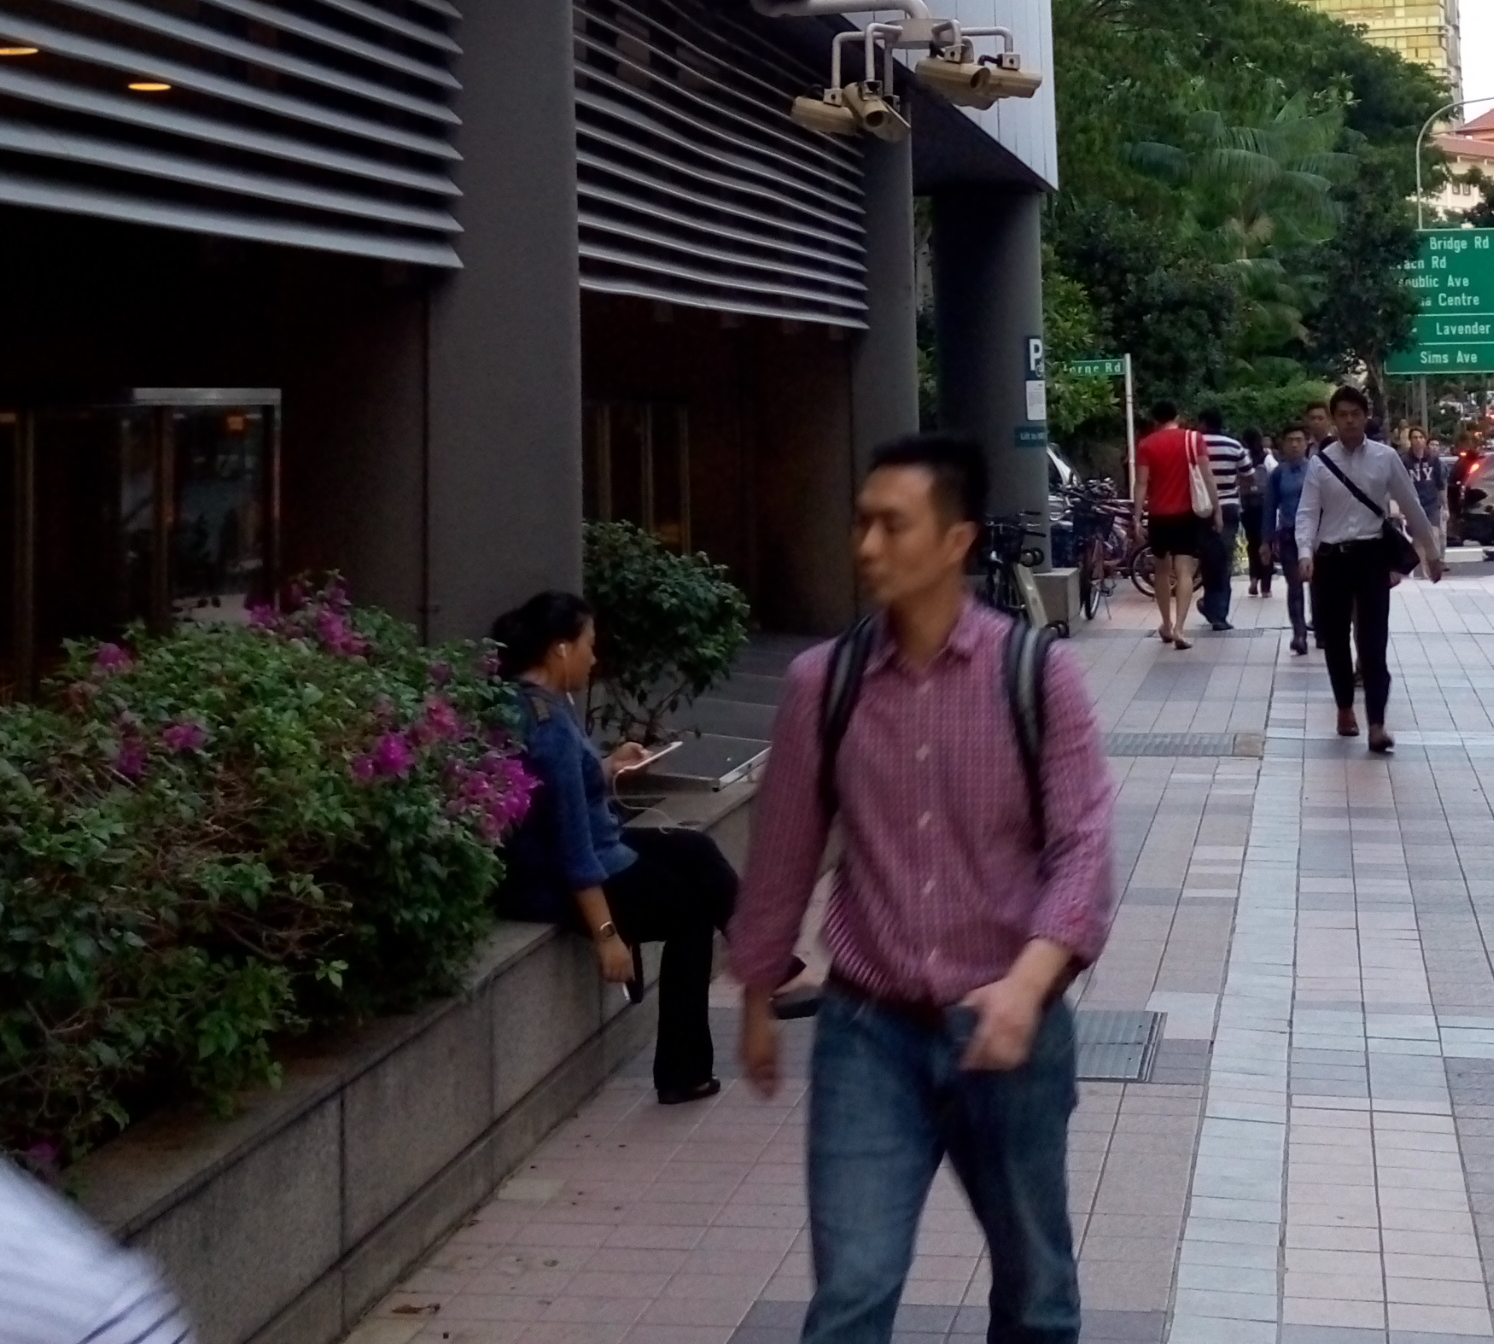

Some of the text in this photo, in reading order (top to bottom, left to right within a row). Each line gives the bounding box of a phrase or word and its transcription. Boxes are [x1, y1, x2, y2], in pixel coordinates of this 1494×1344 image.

[1429, 236, 1489, 253] Bridge Rd
[1431, 256, 1447, 269] Rd
[1447, 274, 1470, 287] Ave
[1438, 292, 1480, 306] Centre
[1435, 321, 1491, 335] Lavender
[1028, 338, 1044, 372] P
[1420, 350, 1478, 364] Sims Ave
[1105, 362, 1121, 373] Rd
